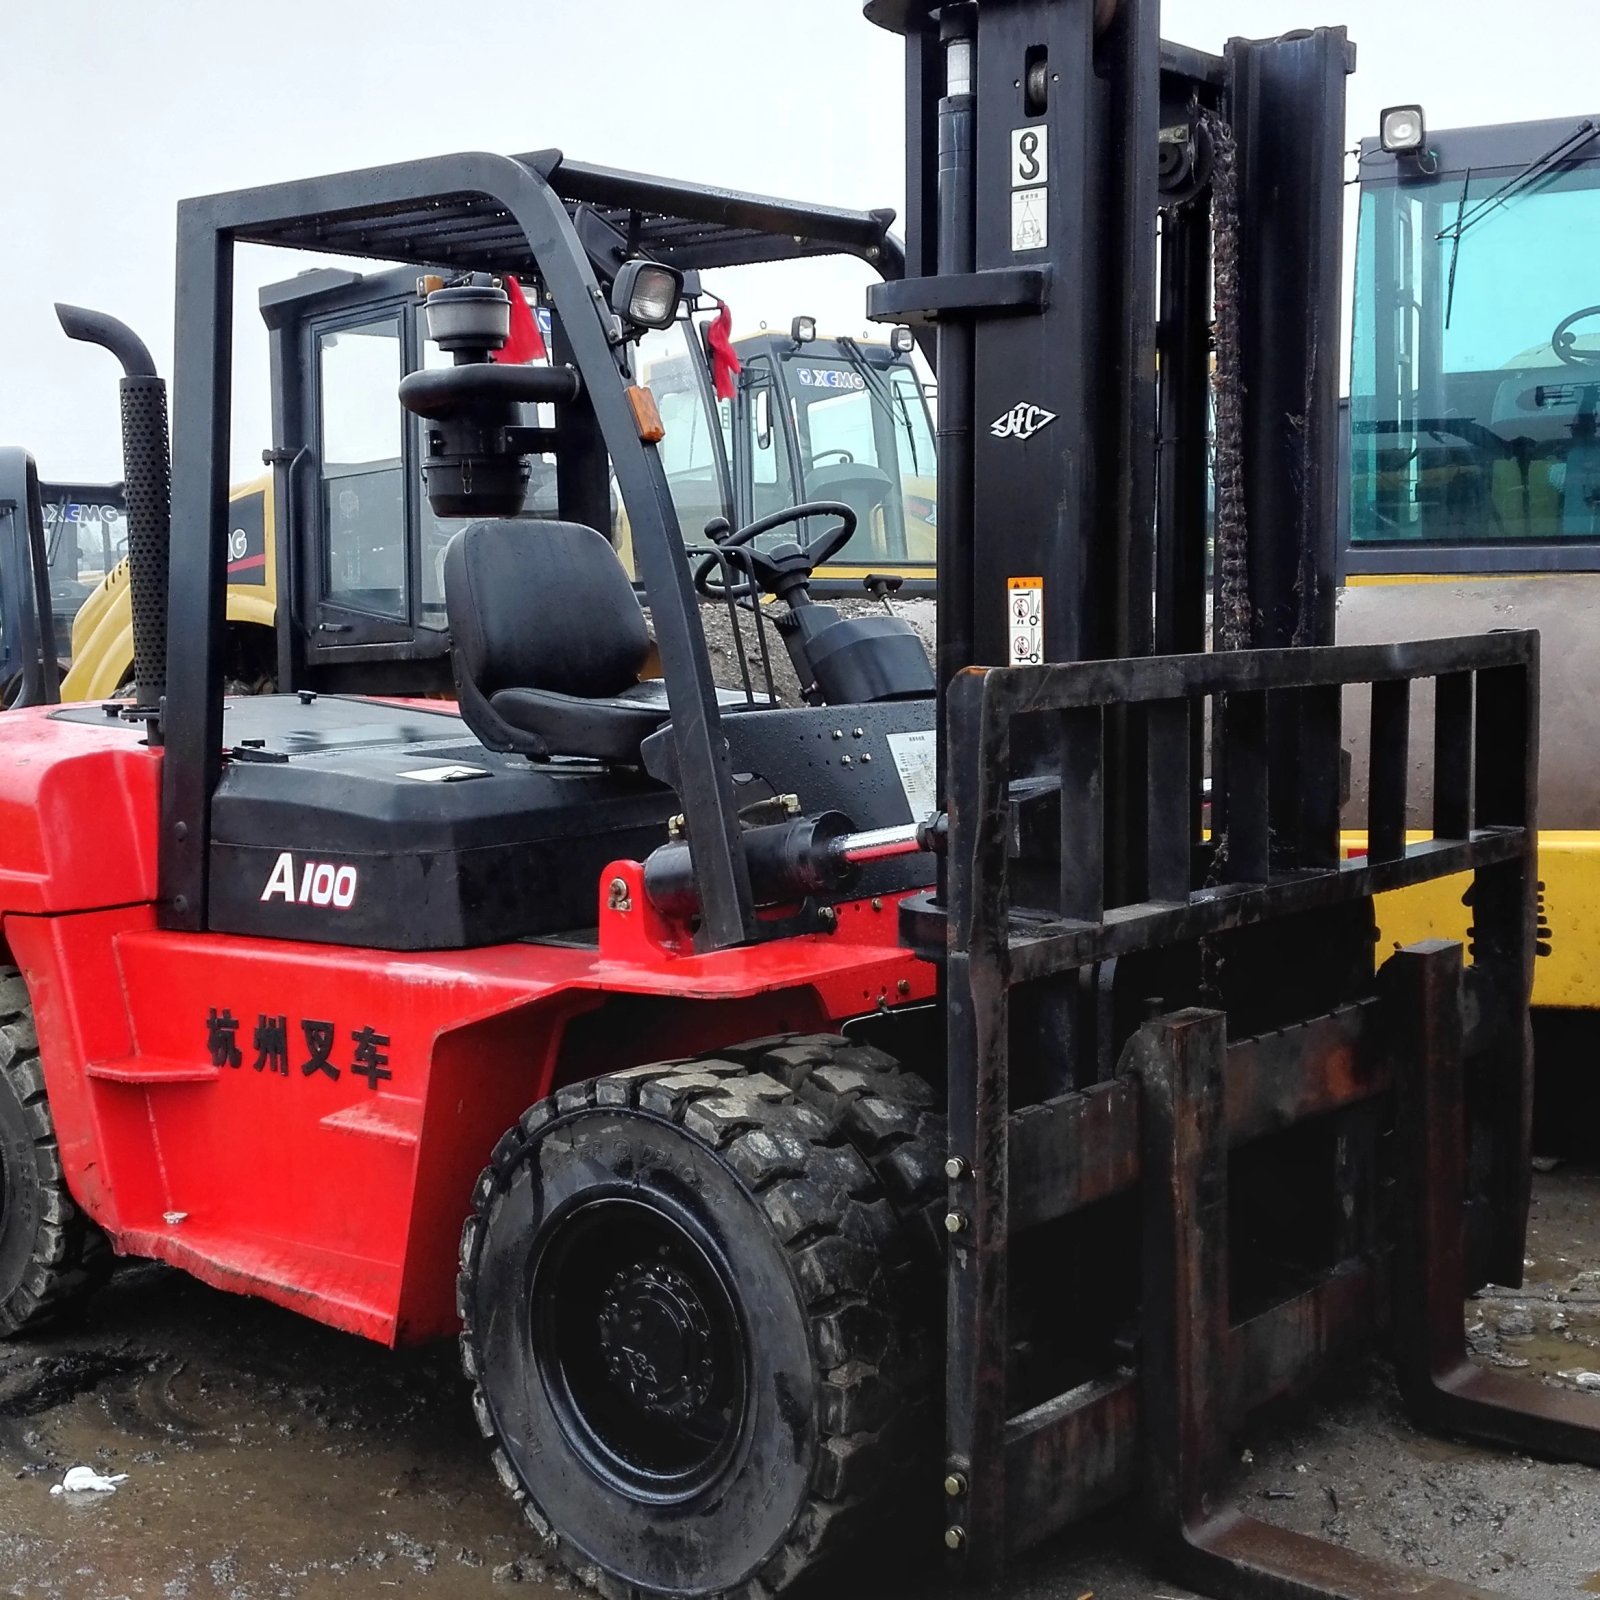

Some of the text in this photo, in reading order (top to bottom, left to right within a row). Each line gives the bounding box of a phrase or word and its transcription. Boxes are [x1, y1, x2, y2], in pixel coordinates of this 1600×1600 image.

[812, 369, 866, 390] XCMG
[46, 503, 119, 524] XCMG
[260, 852, 358, 908] A100
[206, 1007, 392, 1090] 杭州叉车
